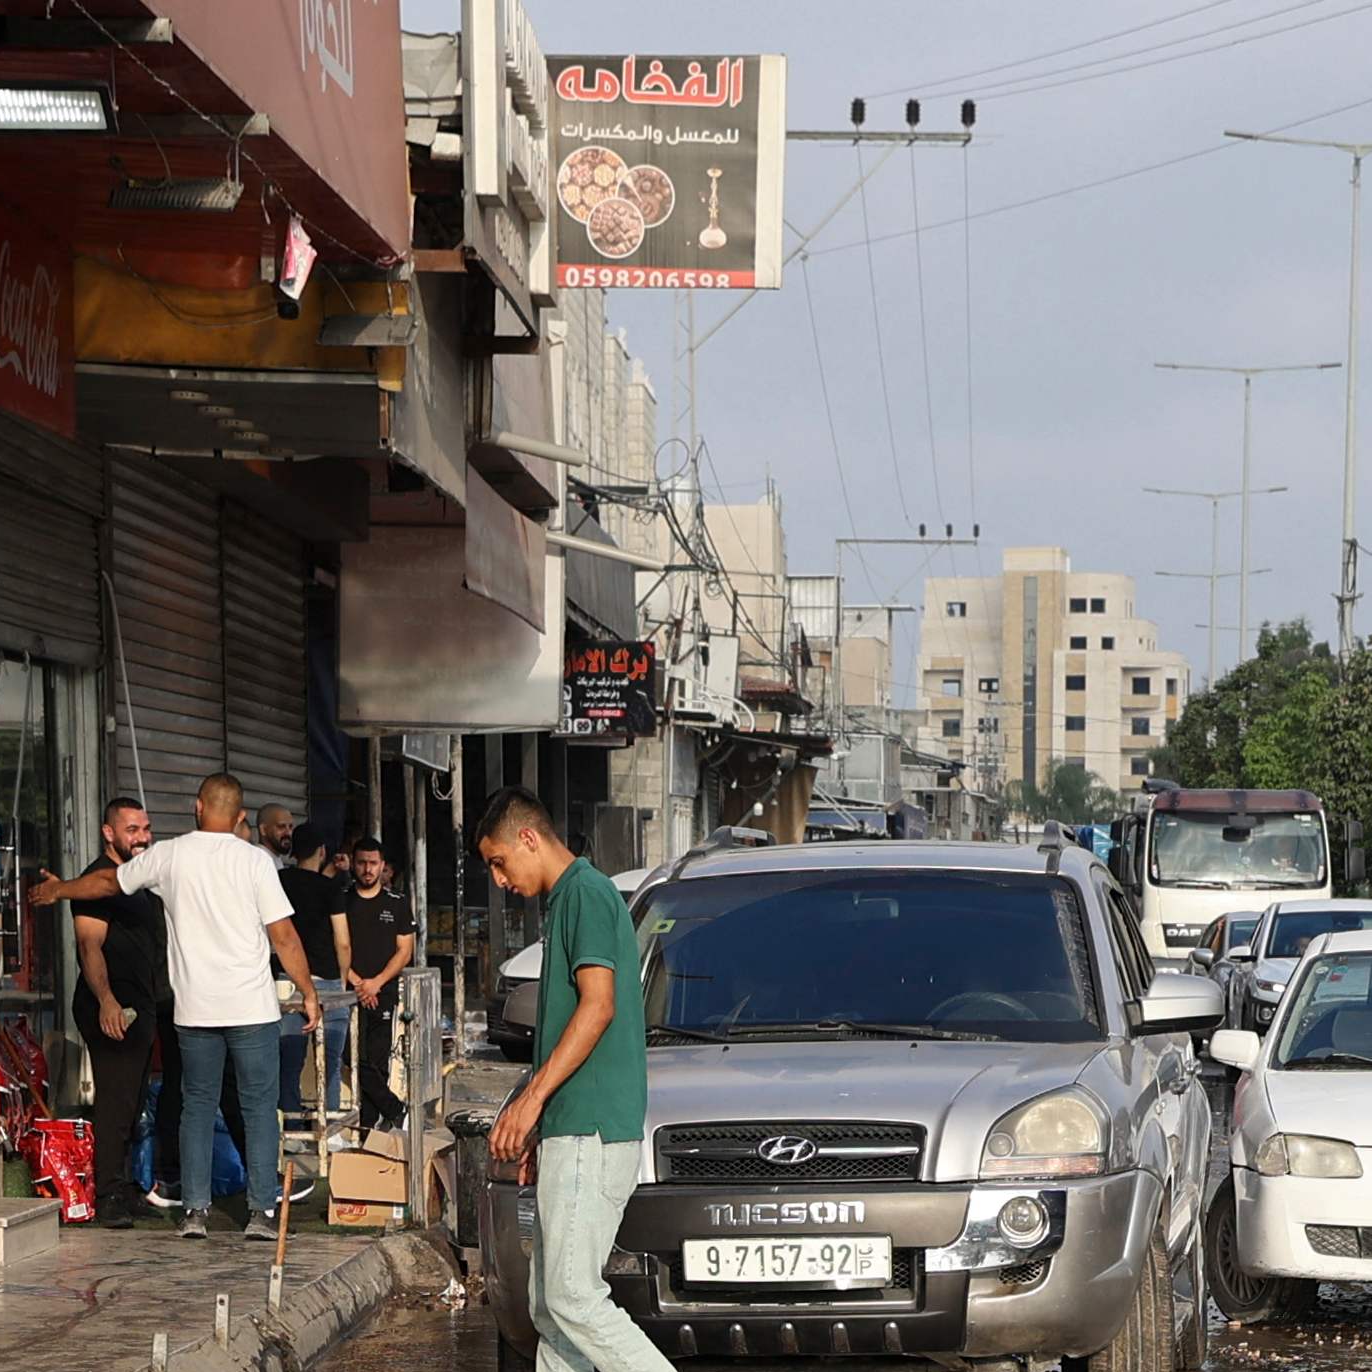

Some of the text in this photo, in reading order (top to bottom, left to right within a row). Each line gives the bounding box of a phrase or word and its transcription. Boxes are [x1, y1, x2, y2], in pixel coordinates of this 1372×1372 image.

[556, 54, 744, 107] الفخامه
[560, 122, 740, 145] للمعسل والمكسرات
[1166, 928, 1202, 937] DAF
[704, 1200, 866, 1226] TUCSON
